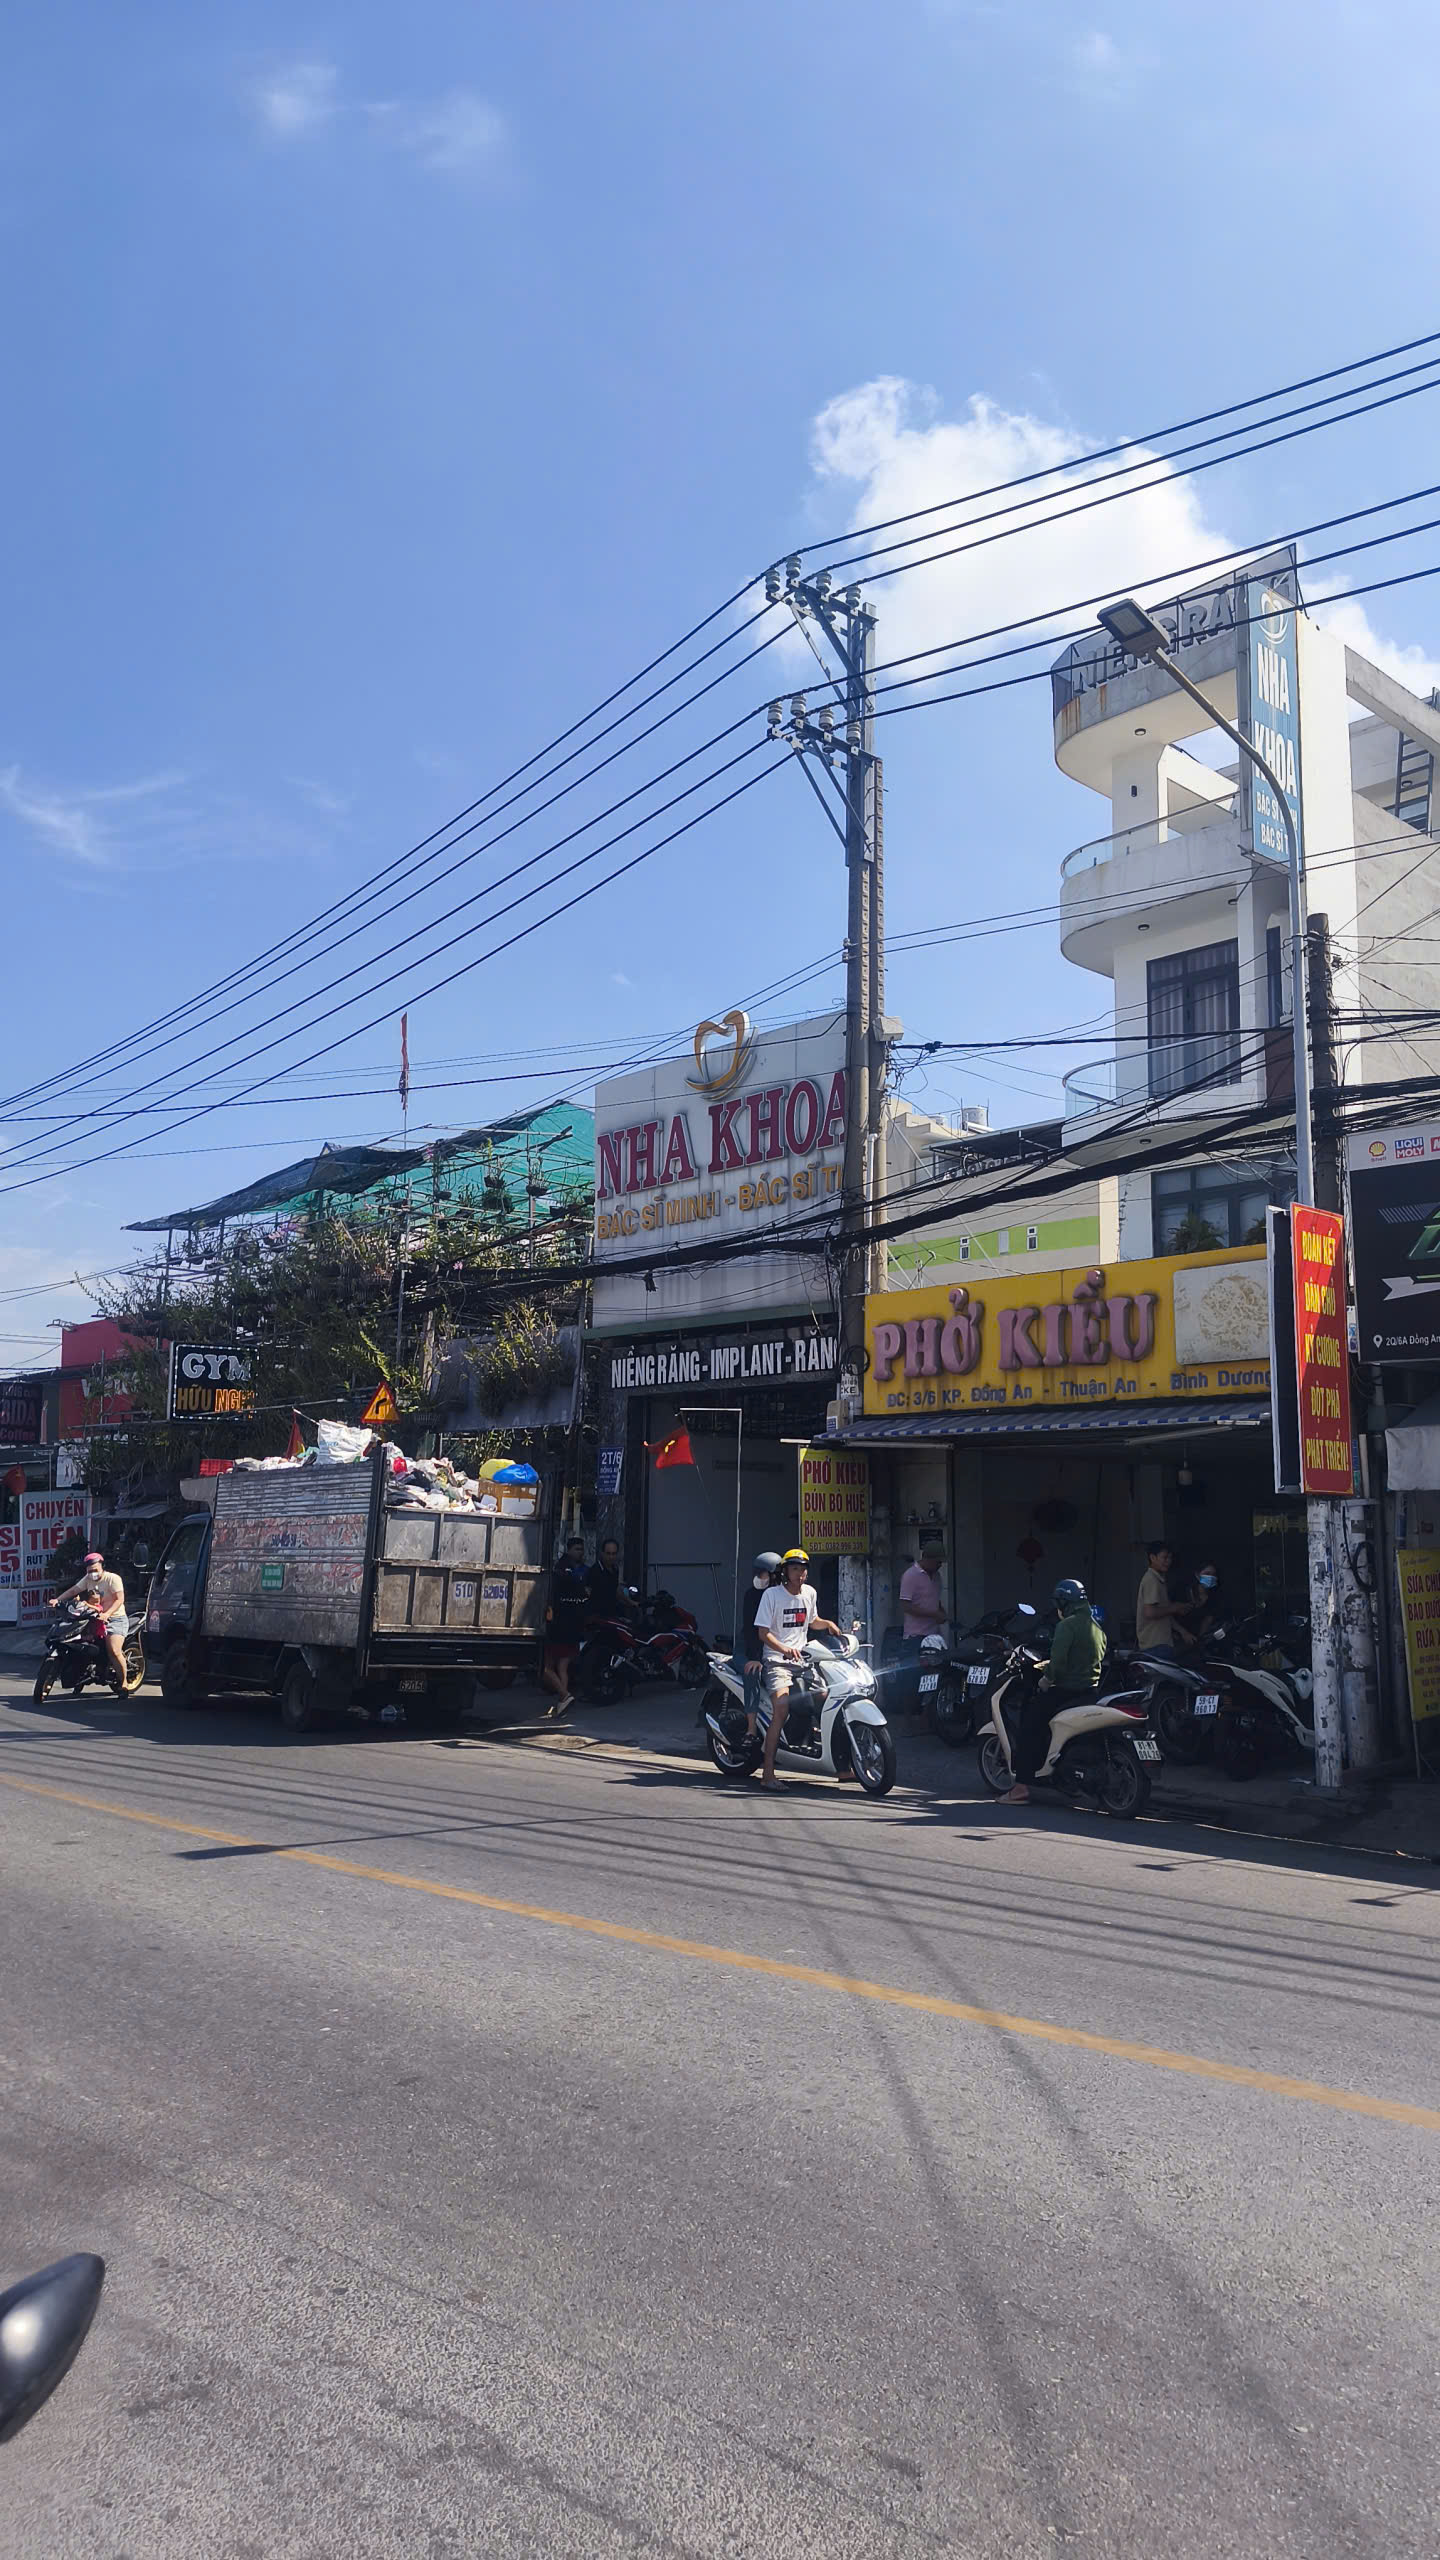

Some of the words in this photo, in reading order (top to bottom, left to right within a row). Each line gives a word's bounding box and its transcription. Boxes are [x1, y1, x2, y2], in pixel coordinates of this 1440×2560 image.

[1257, 642, 1290, 715] NHA
[1254, 720, 1298, 798] KHOA
[1261, 821, 1275, 848] BÁC
[597, 1113, 699, 1199] NHA
[707, 1070, 846, 1175] KHOA
[1395, 1138, 1423, 1149] LIQUI
[1396, 1147, 1424, 1158] MOLY
[597, 1204, 637, 1240] BÁC
[641, 1195, 663, 1231] SĨ
[665, 1190, 721, 1225] MINH
[738, 1173, 785, 1212] BÁC
[792, 1162, 814, 1200] SĨ
[1304, 1276, 1320, 1313] DÂN
[872, 1287, 984, 1382] PHỞ
[182, 1353, 251, 1381] GYM
[611, 1345, 655, 1389] NIỀNG
[657, 1344, 700, 1385] RĂNG
[710, 1336, 784, 1380] IMPLANT
[913, 1391, 936, 1407] 3/6
[1012, 1384, 1032, 1400] An
[1059, 1379, 1107, 1400] Thuận
[1114, 1377, 1136, 1394] An
[1170, 1371, 1208, 1390] Bình
[1217, 1369, 1271, 1389] Dương
[803, 1455, 832, 1484] PHỞ
[804, 1488, 826, 1512] BÚN
[829, 1488, 842, 1512] BÒ
[817, 1520, 832, 1537] KHO
